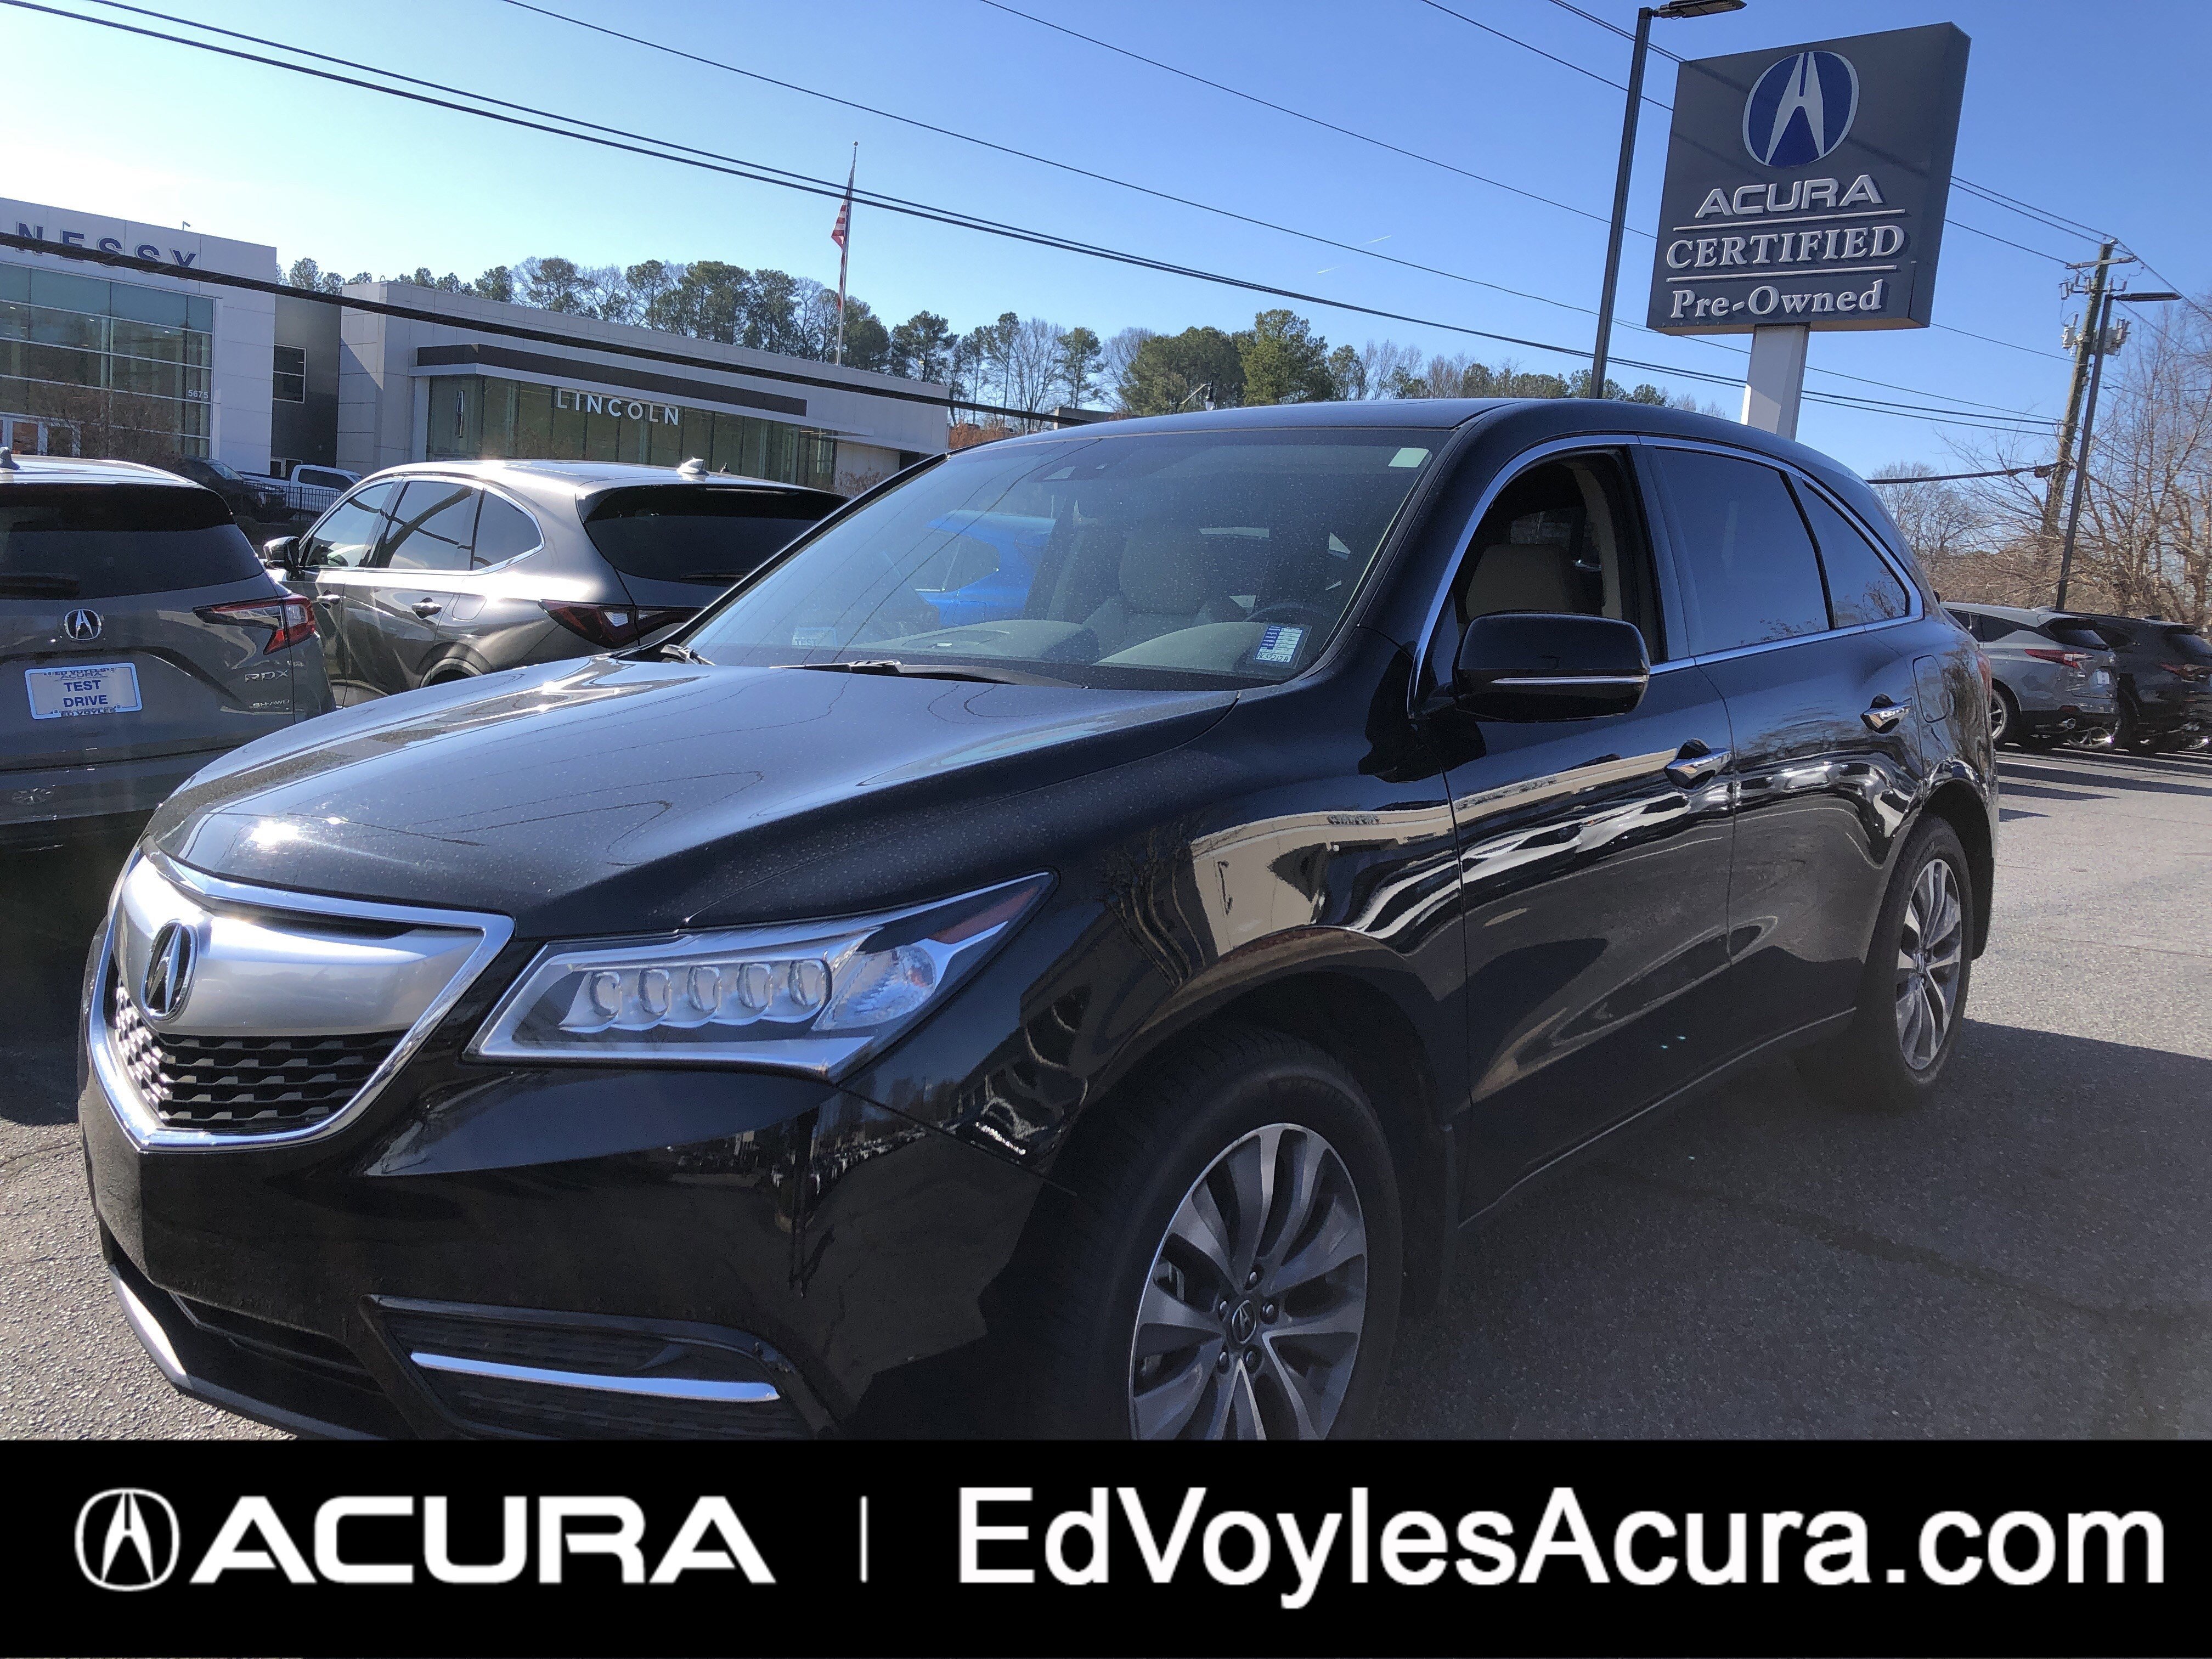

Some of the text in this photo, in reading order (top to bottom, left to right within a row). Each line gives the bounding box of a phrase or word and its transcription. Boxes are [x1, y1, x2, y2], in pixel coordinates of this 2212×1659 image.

[1695, 174, 1883, 219] ACURA
[1666, 225, 1905, 269] CERTIFIED
[1670, 278, 1884, 319] Pre-Owned
[188, 389, 208, 399] 5675
[557, 387, 679, 426] LINCOLN
[244, 669, 289, 683] RDX
[63, 679, 101, 692] TEST
[63, 695, 109, 708] DRIVE
[252, 699, 290, 708] SH-AWD
